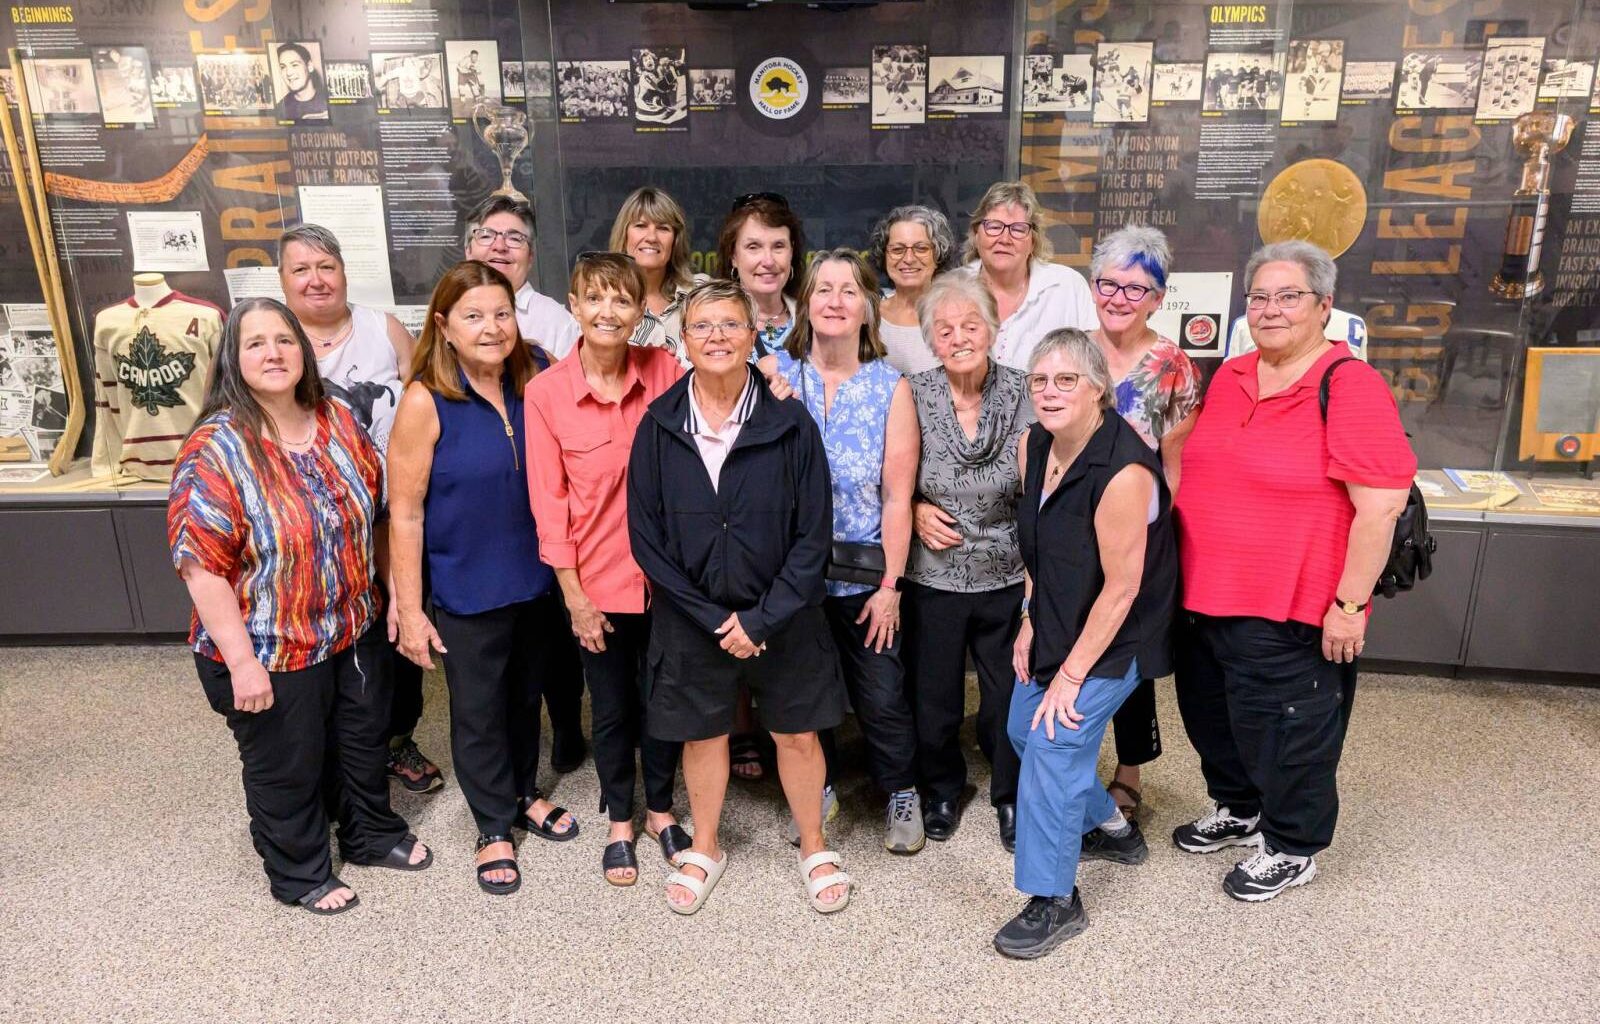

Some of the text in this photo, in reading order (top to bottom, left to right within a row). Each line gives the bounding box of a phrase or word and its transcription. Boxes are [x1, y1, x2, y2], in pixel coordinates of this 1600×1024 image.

[11, 6, 74, 23] BEGINNINGS
[1210, 5, 1266, 23] OLYMPICS
[754, 62, 803, 84] MANITOBA HOCKEY
[758, 100, 773, 114] HALL
[784, 100, 800, 114] FAME
[291, 132, 347, 148] A GROWING
[1154, 135, 1179, 151] WON
[293, 150, 379, 166] HOCKEY OUTPOST
[1103, 155, 1114, 170] IN
[1167, 154, 1178, 170] IN
[295, 168, 379, 184] ON THE PRAIRIES
[1102, 173, 1164, 189] FACE OF BIG
[1099, 210, 1177, 226] THEY ARE REAL
[1566, 219, 1600, 234] AN EX
[1167, 301, 1190, 310] 1972
[185, 317, 199, 338] A
[1347, 317, 1365, 348] C
[119, 360, 187, 387] CANADA
